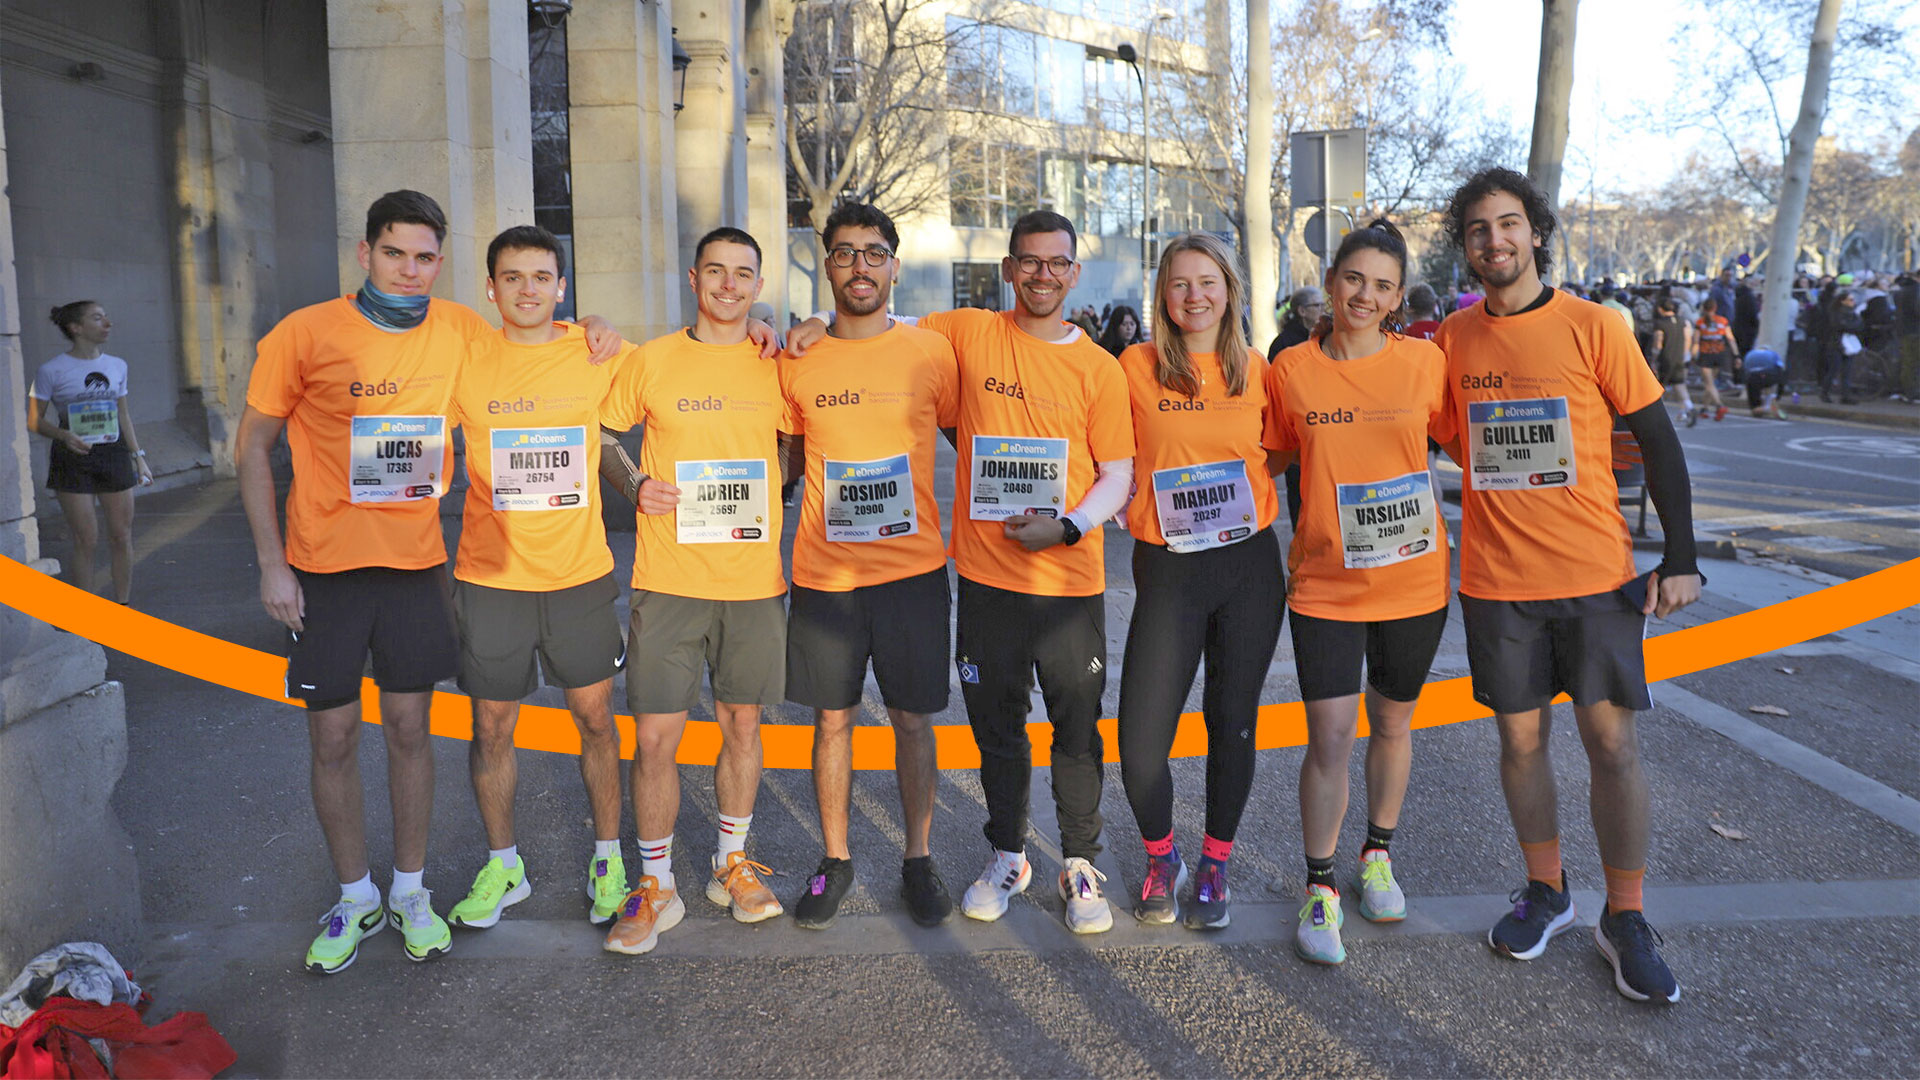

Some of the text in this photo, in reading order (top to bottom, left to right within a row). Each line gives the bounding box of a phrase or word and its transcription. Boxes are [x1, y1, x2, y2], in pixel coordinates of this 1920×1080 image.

[349, 379, 398, 397] eada
[1461, 371, 1502, 389] eada
[488, 397, 534, 414] eada
[677, 395, 722, 412] eada
[815, 390, 860, 408] eada
[1158, 398, 1204, 412] eada
[1306, 408, 1354, 426] eada
[1505, 406, 1544, 417] eDreams
[392, 422, 426, 432] eDreams
[1483, 424, 1555, 446] GUILLEM
[530, 434, 567, 444] eDreams
[376, 440, 422, 459] LUCAS
[1010, 444, 1046, 455] eDreams
[1506, 448, 1531, 460] 24111
[387, 462, 413, 473] 17383
[510, 450, 570, 470] MATTEO
[526, 472, 554, 483] 26754
[714, 466, 748, 477] eDreams
[856, 465, 892, 478] eDreams
[980, 460, 1058, 481] JOHANNES
[1192, 468, 1226, 482] eDreams
[697, 484, 750, 502] ADRIEN
[839, 480, 898, 502] COSIMO
[1003, 483, 1033, 494] 20480
[1377, 482, 1411, 498] eDreams
[1172, 483, 1236, 511] MAHAUT
[710, 504, 737, 515] 25697
[854, 503, 884, 516] 20900
[1193, 508, 1222, 523] 20297
[1355, 498, 1421, 526] VASILIKI
[1377, 523, 1405, 539] 21500
